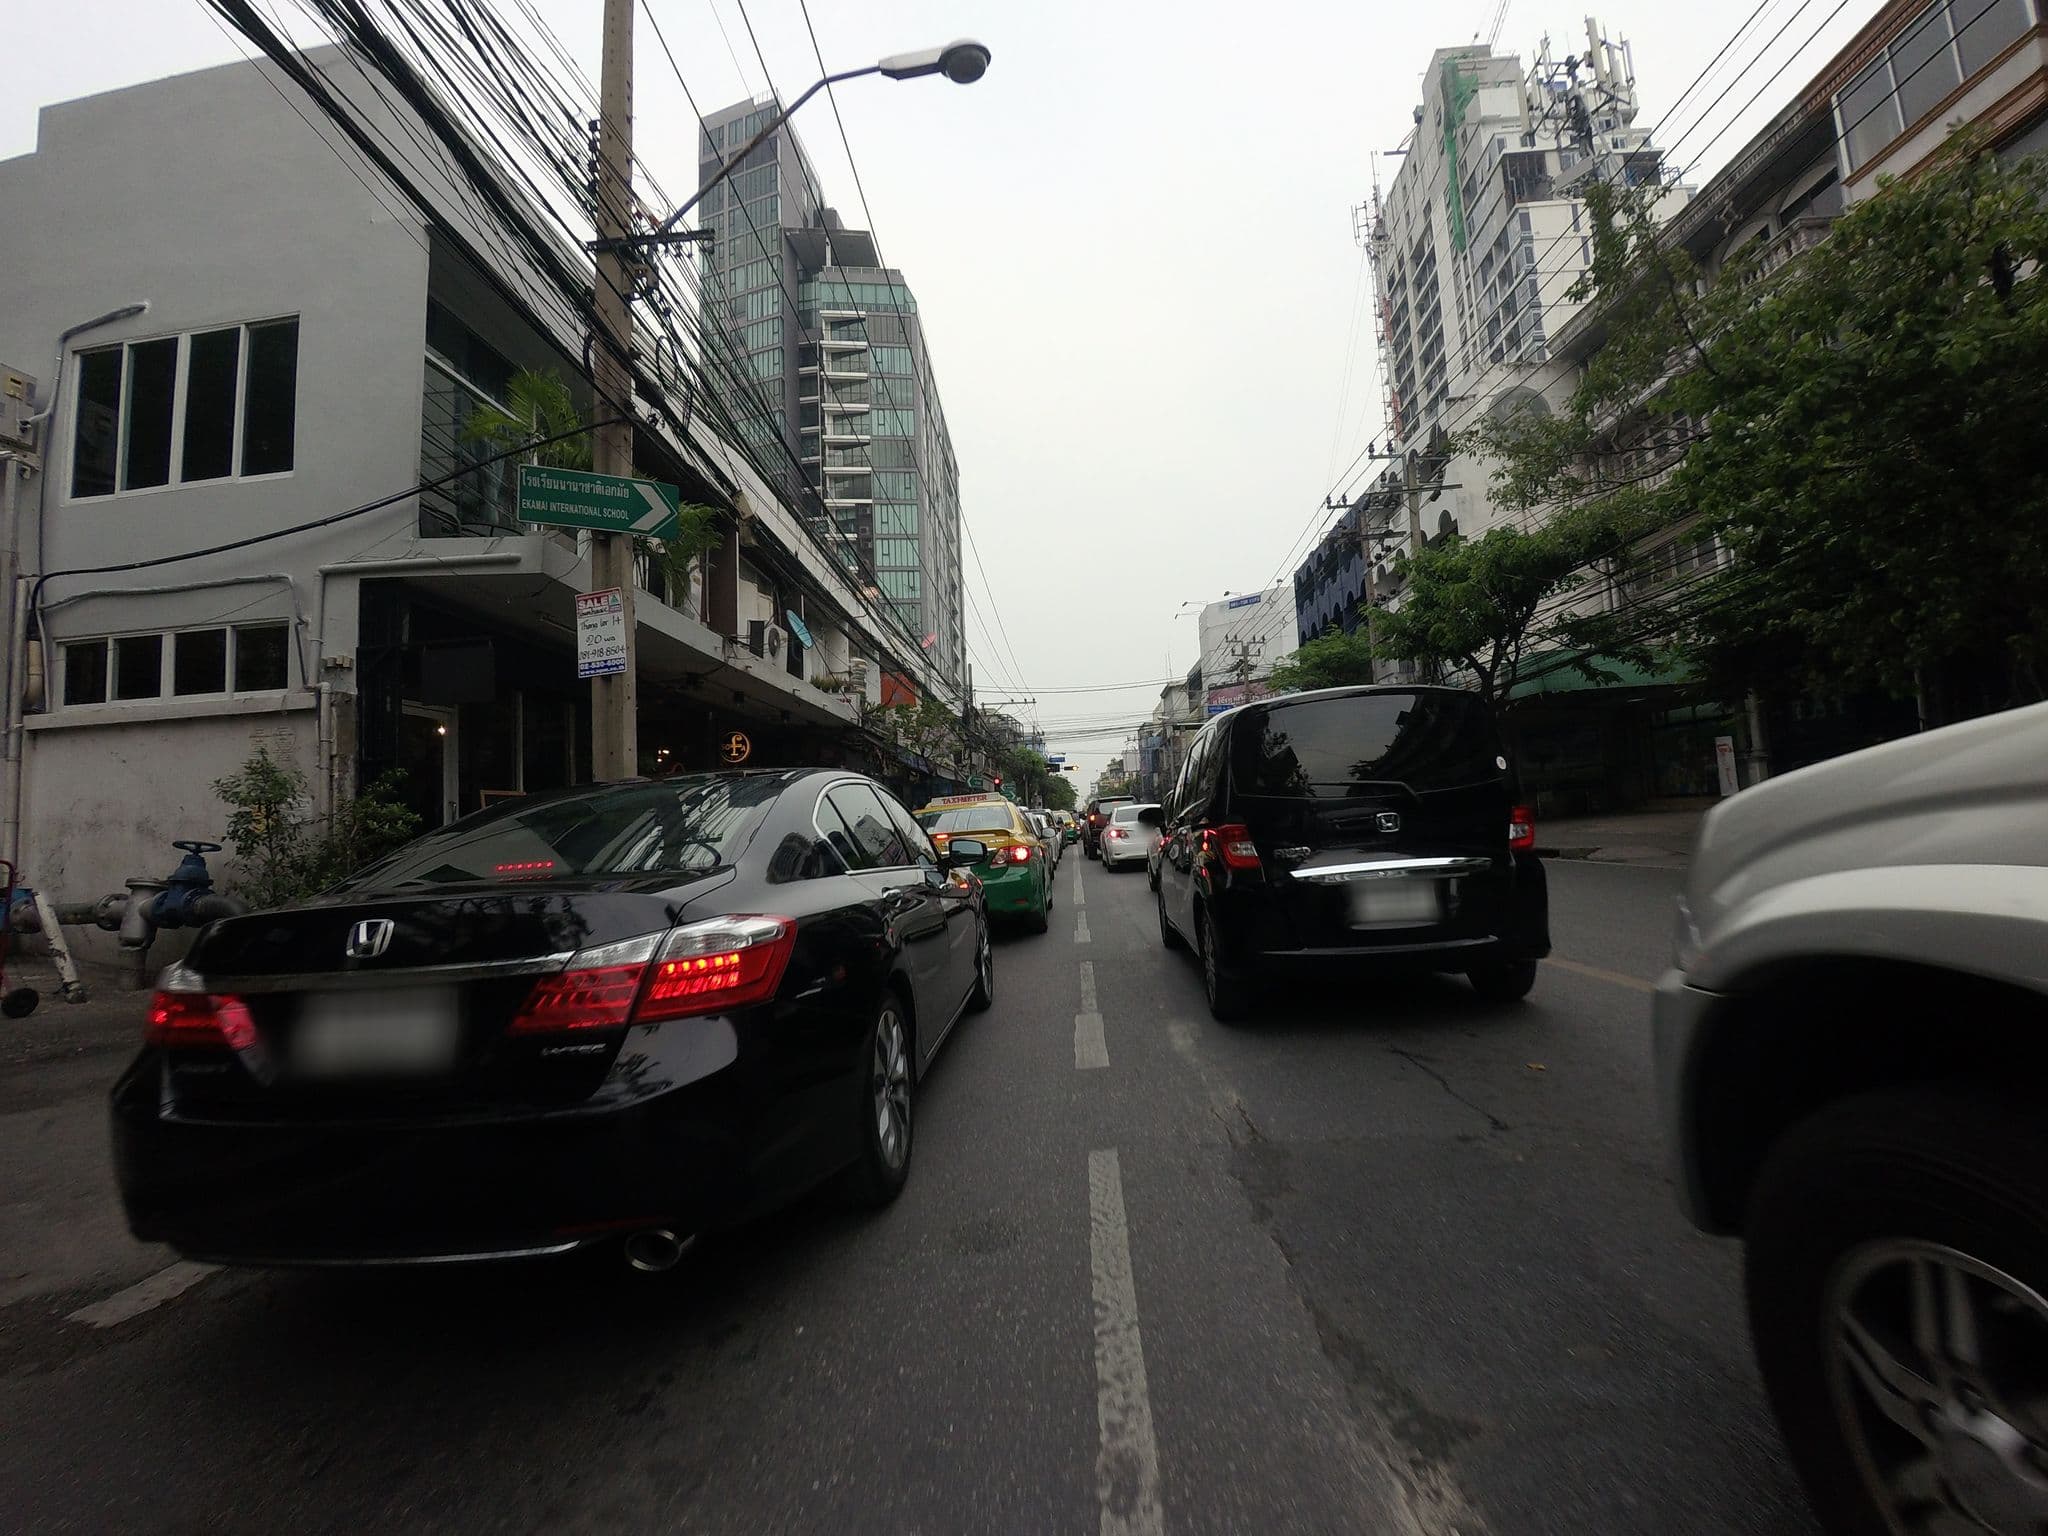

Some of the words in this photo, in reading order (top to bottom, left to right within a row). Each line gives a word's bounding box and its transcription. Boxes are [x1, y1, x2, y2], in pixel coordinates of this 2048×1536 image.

[521, 469, 630, 499] โรงเรียนนานาชาติเอกมัย
[521, 498, 548, 511] EKAMAI
[549, 501, 602, 517] INTERNATIONAL
[603, 507, 630, 520] SCHOOL
[577, 595, 609, 610] SALE
